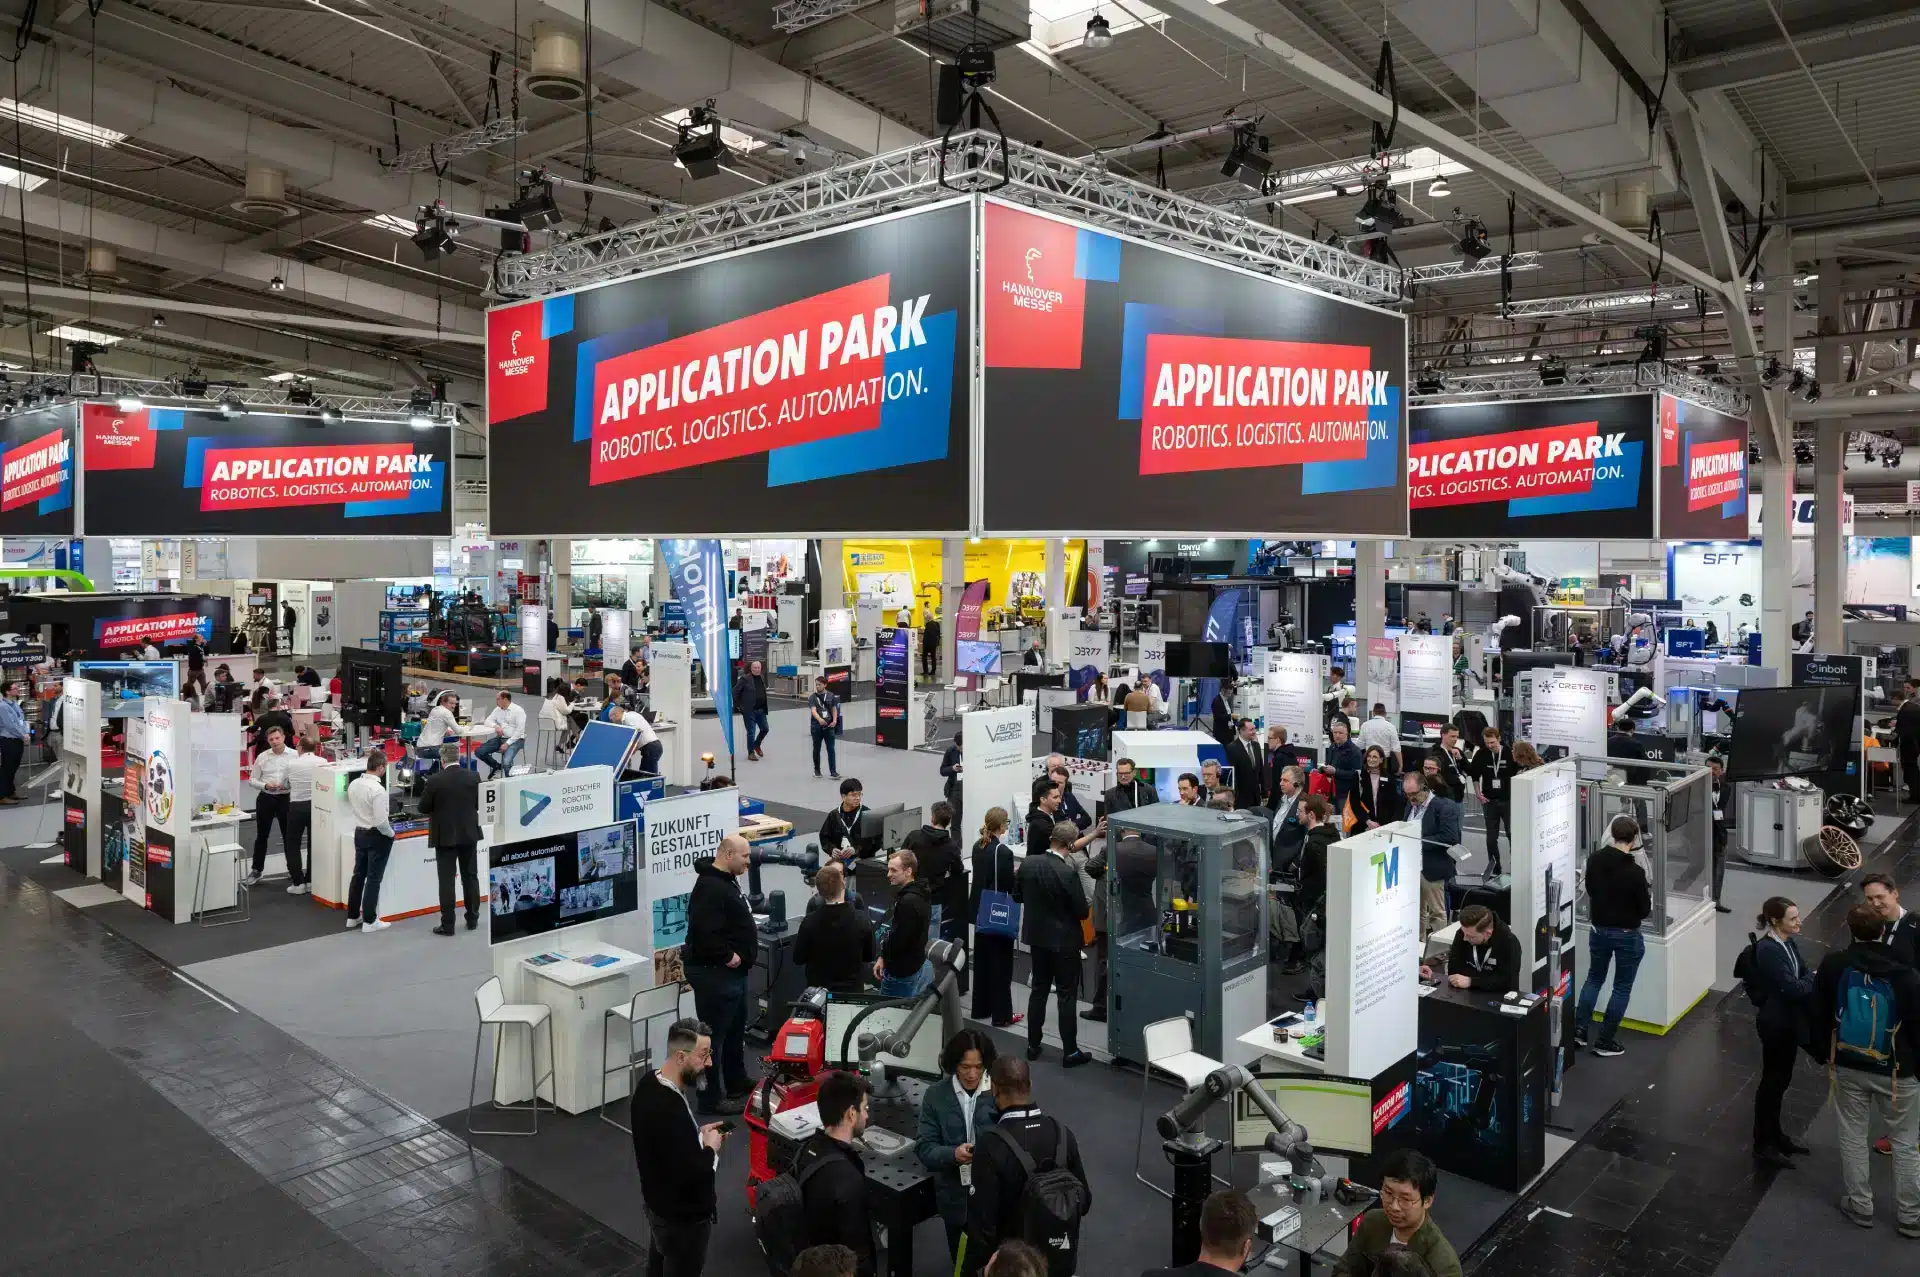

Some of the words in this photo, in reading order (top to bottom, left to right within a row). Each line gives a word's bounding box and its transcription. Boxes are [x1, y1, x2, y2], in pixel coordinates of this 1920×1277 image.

[1002, 280, 1063, 305] HANNOVER
[1013, 295, 1053, 312] MESSE
[498, 356, 535, 371] HANNOVER
[600, 329, 808, 424] APPLICATION
[818, 293, 932, 371] PARK
[504, 364, 529, 377] MESSE
[1152, 362, 1326, 407] APPLICATION
[1333, 370, 1389, 406] PARK
[599, 424, 677, 463] ROBOTICS.
[682, 403, 773, 446] LOGISTICS.
[777, 367, 928, 424] AUTOMATION.
[96, 434, 140, 442] HANNOVER
[1152, 423, 1232, 451] ROBOTICS.
[1236, 421, 1305, 447] LOGISTICS.
[1308, 420, 1389, 443] AUTOMATION.
[3, 448, 47, 484] APPLICATION
[48, 439, 70, 467] PARK
[1409, 442, 1539, 477] PLICATION
[1547, 432, 1626, 464] PARK
[210, 456, 369, 482] APPLICATION
[376, 453, 433, 474] PARK
[1690, 453, 1728, 479] APPLICATION
[1730, 450, 1744, 471] PARK
[210, 486, 279, 500] ROBOTICS.
[283, 482, 348, 496] LOGISTICS.
[350, 478, 433, 493] AUTOMATION.
[1409, 485, 1436, 499] TICS.
[1440, 476, 1512, 496] LOGISTICS.
[1515, 464, 1624, 488] AUTOMATION.
[500, 542, 518, 550] CHINA
[1703, 553, 1744, 565] SFT
[104, 620, 176, 636] APPLICATION
[178, 616, 207, 627] PARK
[1074, 646, 1102, 656] DBR77
[1144, 650, 1166, 660] DBR7
[1818, 664, 1848, 674] inbolt
[1558, 682, 1596, 691] CRETEC
[1608, 676, 1614, 684] B
[1645, 749, 1663, 760] olt
[486, 789, 496, 804] B
[562, 782, 601, 795] DEUTSCHER
[562, 793, 592, 805] ROBOTIK
[562, 803, 594, 815] VERBAND
[650, 814, 711, 838] ZUKUNFT
[652, 828, 724, 856] GESTALTEN
[502, 854, 510, 862] all
[510, 850, 530, 860] about
[530, 844, 566, 857] automation
[652, 857, 671, 874] mit
[674, 848, 717, 870] ROBOT
[1370, 846, 1399, 894] TM
[1395, 1082, 1410, 1102] PARK
